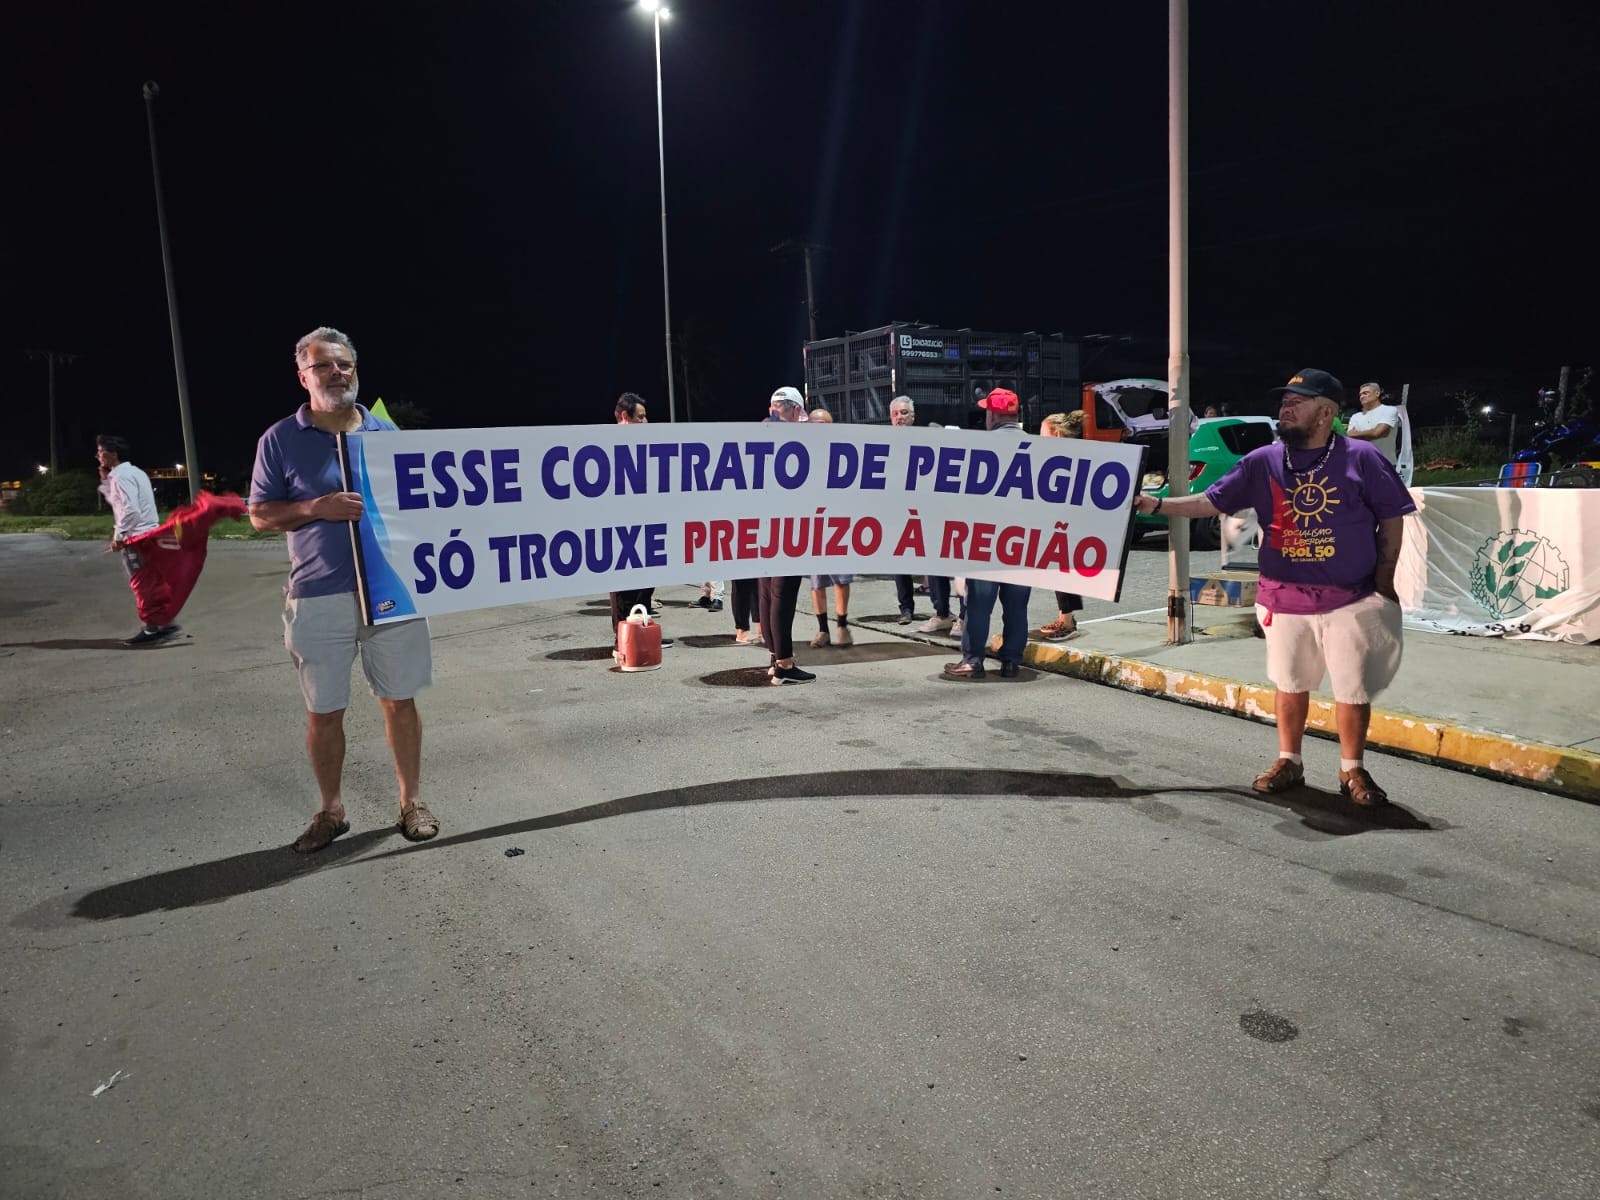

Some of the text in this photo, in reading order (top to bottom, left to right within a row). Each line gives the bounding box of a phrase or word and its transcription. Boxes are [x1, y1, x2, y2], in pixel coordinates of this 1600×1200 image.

[395, 441, 1130, 511] ESSE CONTRATO DE PEDÁGIO
[1282, 528, 1333, 538] SOCIALISMO
[1283, 536, 1336, 546] E LIBERDADE
[413, 507, 1107, 594] SÓ TROUXE PREJUÍZO À REGIÃO
[1281, 545, 1336, 558] PSOL 50
